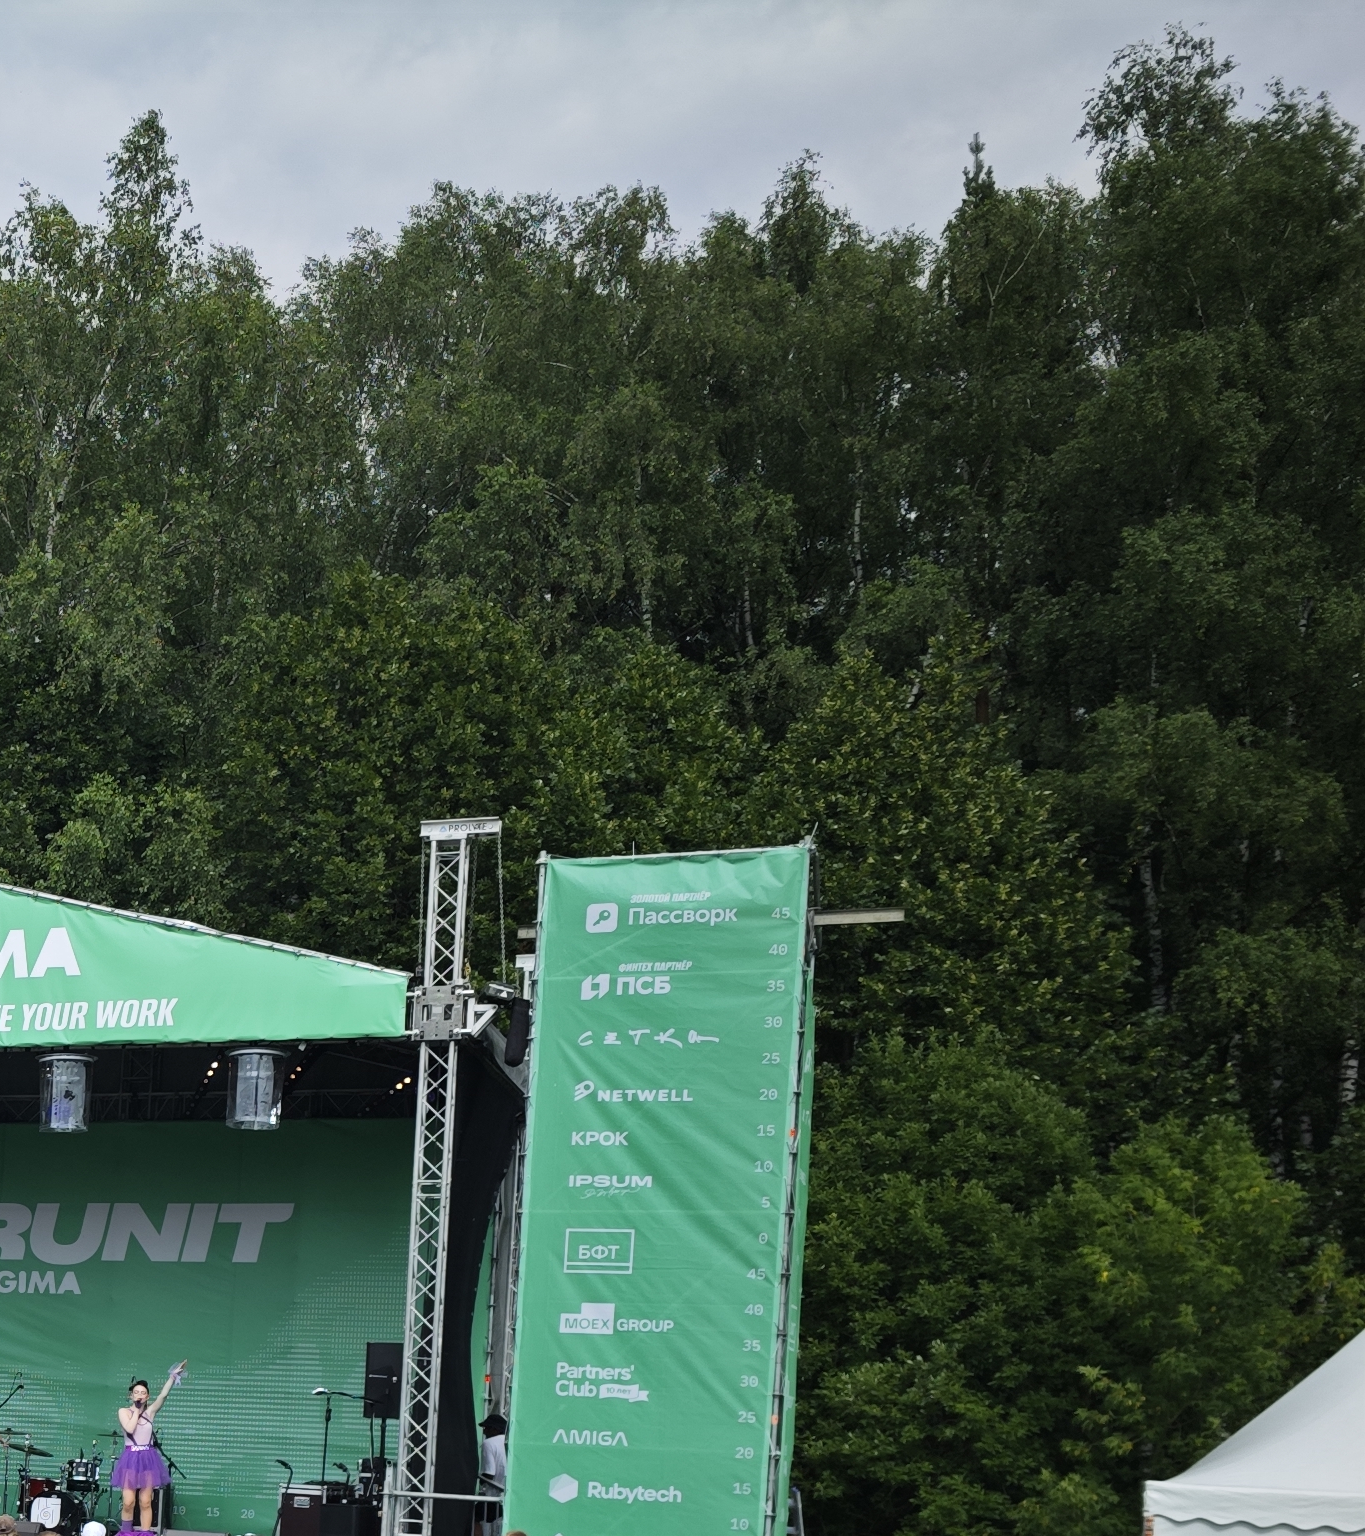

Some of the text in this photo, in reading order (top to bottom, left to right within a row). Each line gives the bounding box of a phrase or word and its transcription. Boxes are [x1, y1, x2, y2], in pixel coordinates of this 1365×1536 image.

[449, 822, 487, 833] PROLYTE
[628, 907, 738, 926] Пассворк
[772, 907, 791, 920] 45
[769, 944, 788, 956] 40
[616, 976, 671, 995] ПСБ
[767, 980, 786, 992] 35
[20, 1000, 91, 1032] YOUR
[94, 997, 178, 1029] WORK
[764, 1017, 783, 1028] 30
[762, 1053, 780, 1065] 25
[597, 1089, 694, 1102] NETWELL
[759, 1089, 778, 1101] 20
[757, 1125, 776, 1137] 15
[571, 1131, 629, 1146] КРОК
[754, 1161, 773, 1173] 10
[569, 1175, 653, 1188] IPSUM
[762, 1197, 771, 1209] 5
[758, 1232, 768, 1245] 0
[578, 1245, 620, 1260] БФТ
[747, 1268, 766, 1281] 45
[744, 1303, 764, 1317] 40
[564, 1317, 674, 1333] MOEX GROUP
[742, 1339, 761, 1352] 35
[556, 1362, 635, 1381] Partners'
[739, 1375, 759, 1388] 30
[555, 1380, 597, 1398] Club
[606, 1387, 632, 1397] 10 лет
[737, 1411, 756, 1424] 25
[553, 1429, 629, 1447] AMIGA
[734, 1447, 754, 1460] 20
[587, 1482, 682, 1504] Rubytech
[733, 1482, 751, 1496] 15
[206, 1506, 220, 1518] 15
[240, 1508, 255, 1519] 20
[730, 1518, 749, 1531] 10
